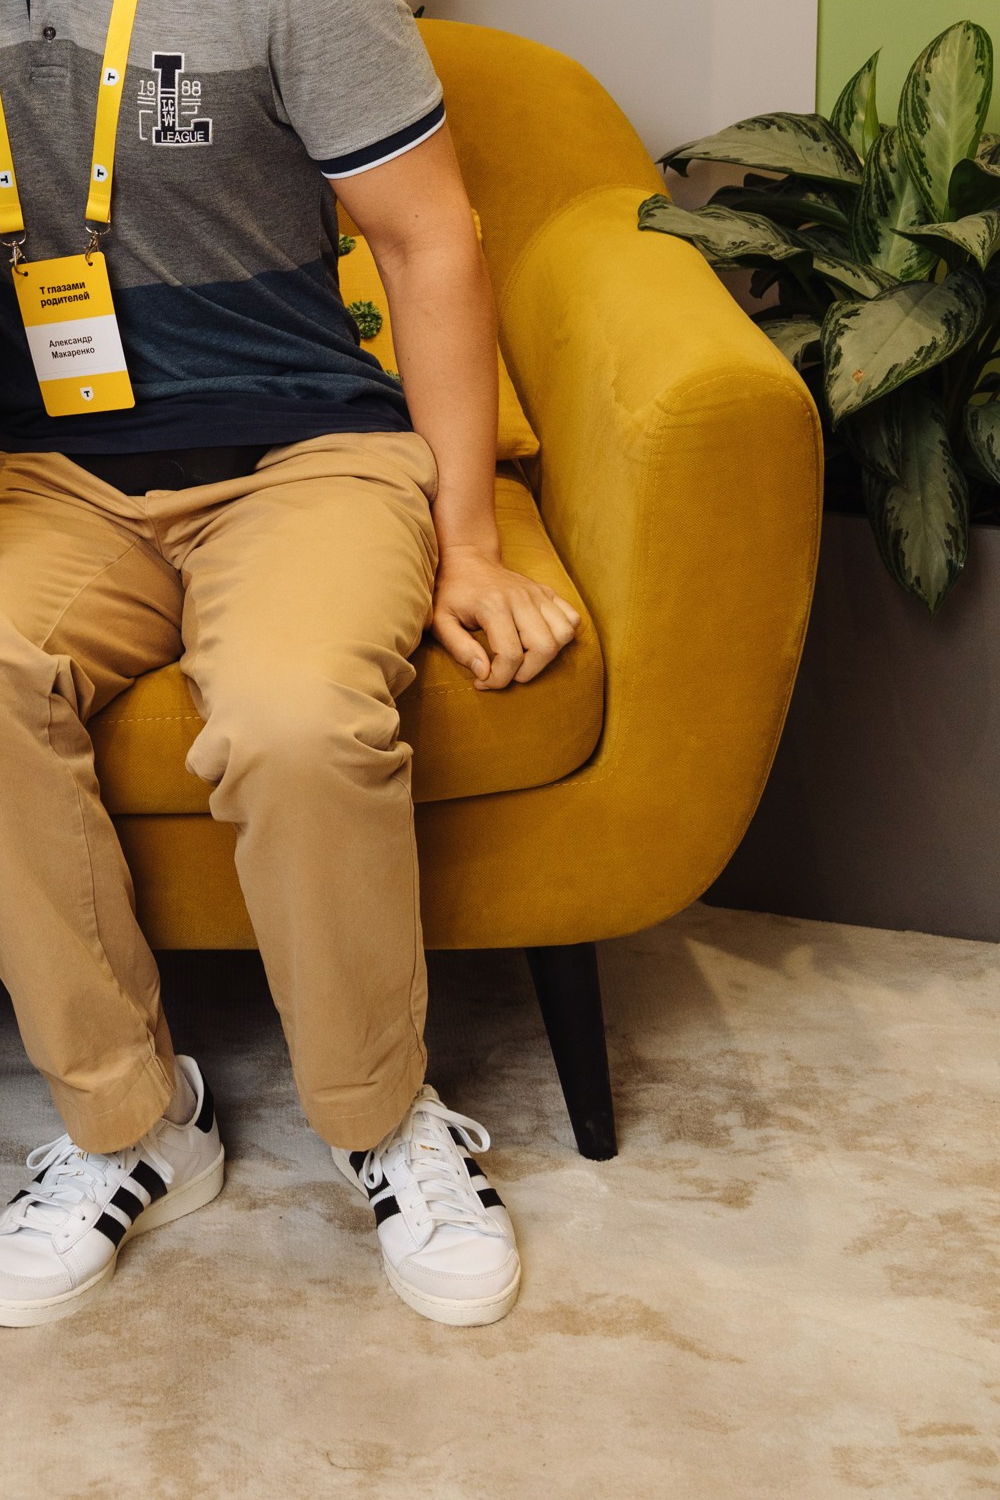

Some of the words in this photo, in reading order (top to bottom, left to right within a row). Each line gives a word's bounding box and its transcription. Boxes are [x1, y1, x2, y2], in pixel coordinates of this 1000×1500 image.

[138, 80, 156, 96] 19
[181, 80, 201, 96] 88
[161, 131, 205, 143] LEAGUE
[47, 281, 86, 295] глазами
[40, 291, 90, 308] родителей
[49, 334, 93, 348] Александр
[51, 347, 95, 360] Макаренко
